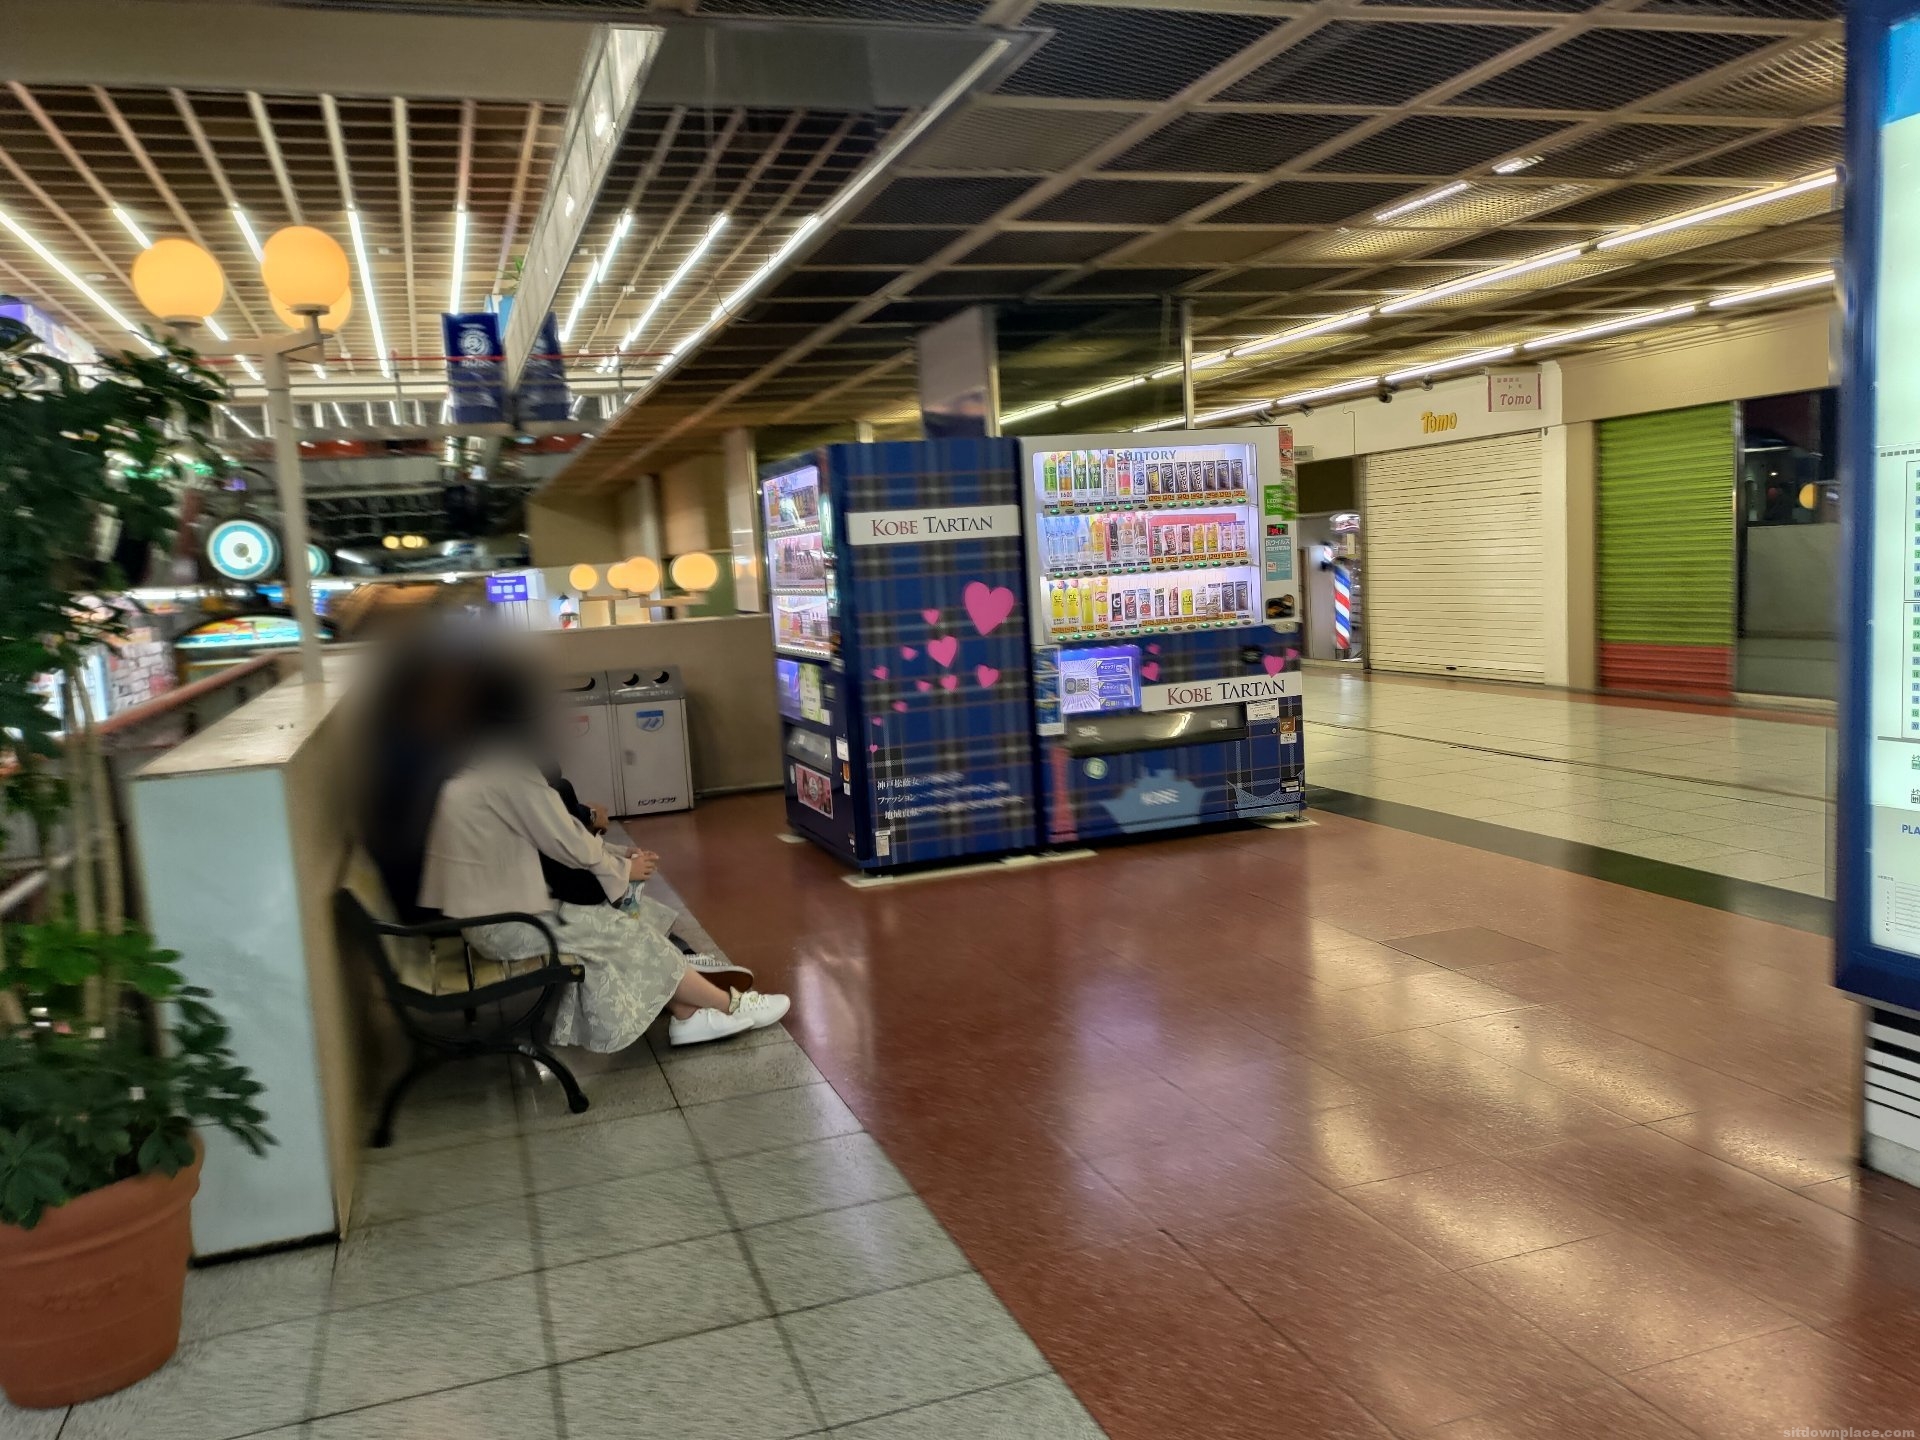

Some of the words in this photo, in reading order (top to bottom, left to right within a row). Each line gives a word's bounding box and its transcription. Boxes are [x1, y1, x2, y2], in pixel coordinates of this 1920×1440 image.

[1500, 394, 1532, 406] Tomo
[1421, 411, 1458, 434] Tomo
[871, 519, 918, 537] KOBE
[923, 515, 993, 533] TARTAN
[1167, 686, 1213, 706] KOBE
[1217, 679, 1285, 700] TARTAN
